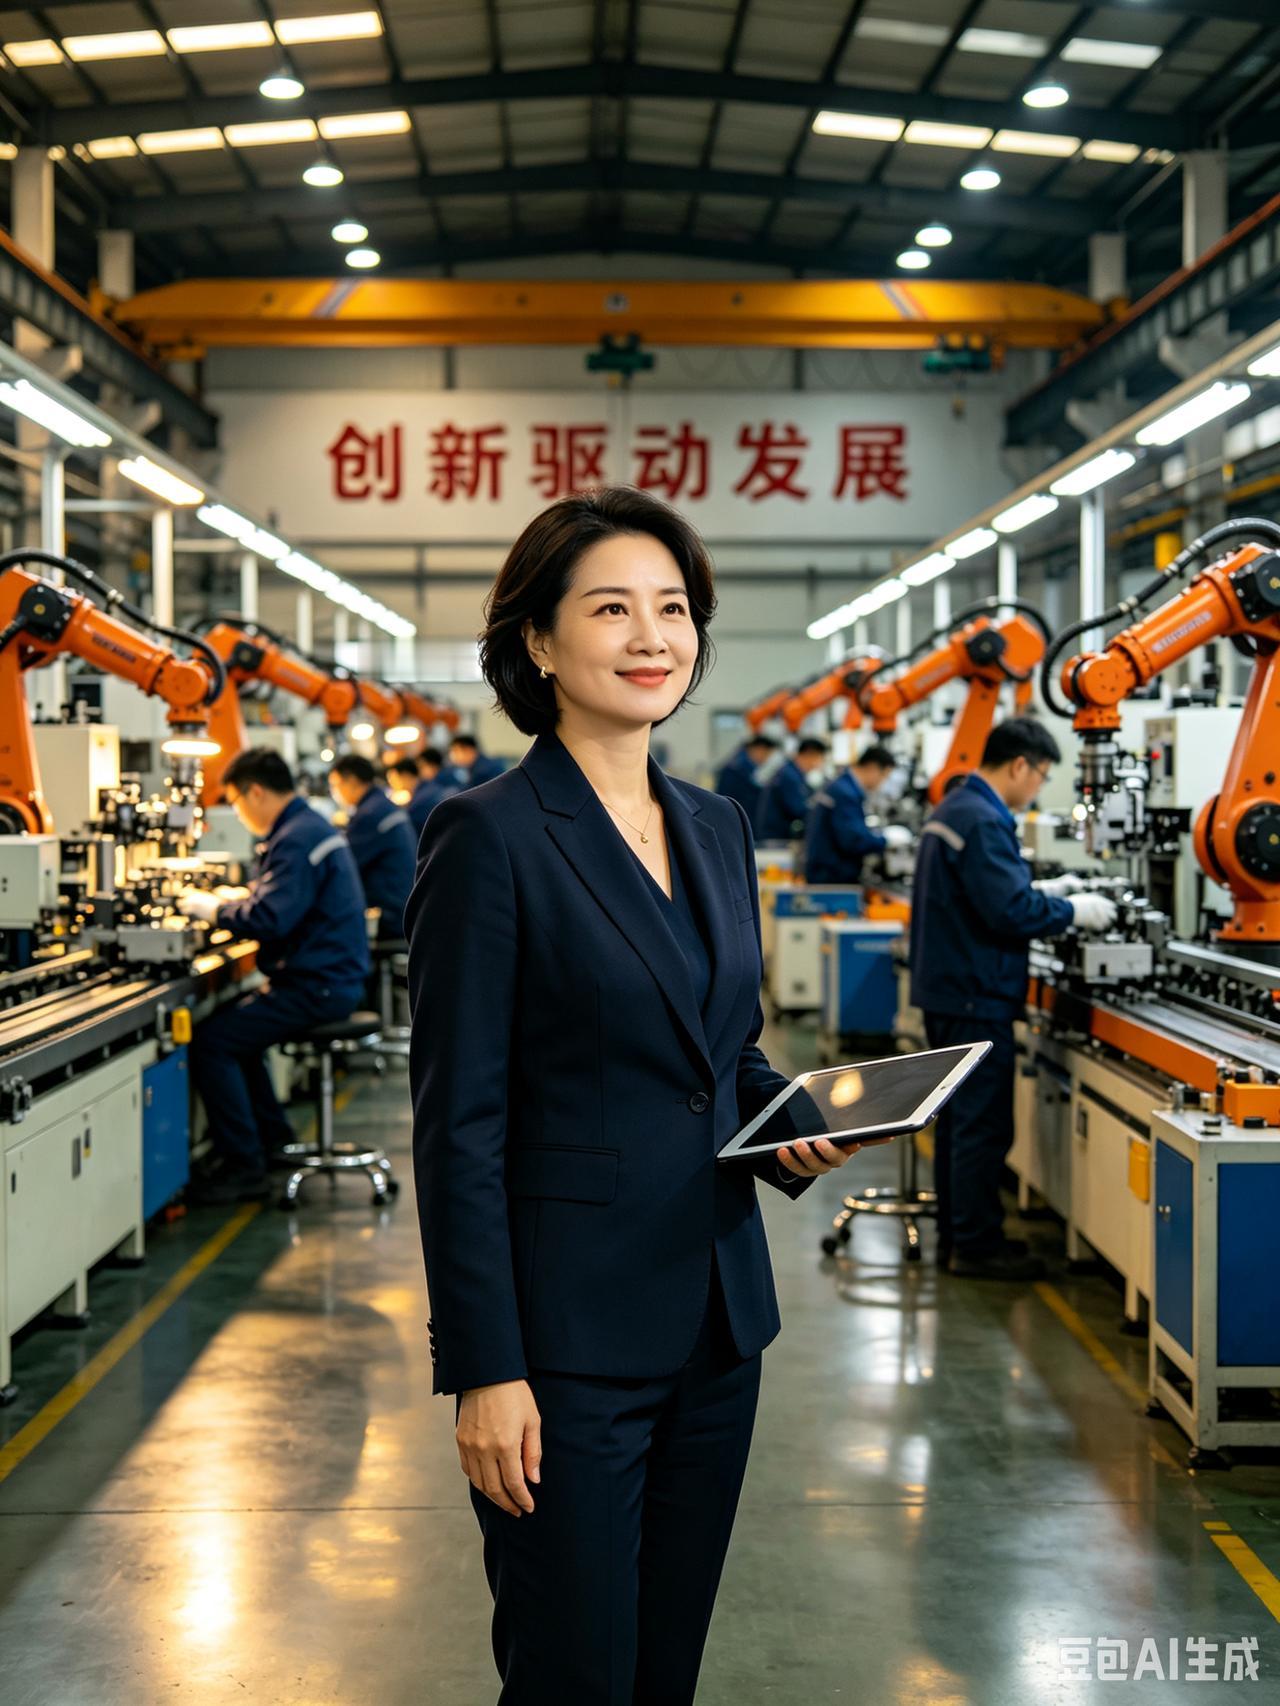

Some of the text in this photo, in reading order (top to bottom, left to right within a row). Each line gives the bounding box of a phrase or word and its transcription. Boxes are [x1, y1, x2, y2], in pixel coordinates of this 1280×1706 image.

[328, 421, 911, 502] 创新驱动发展
